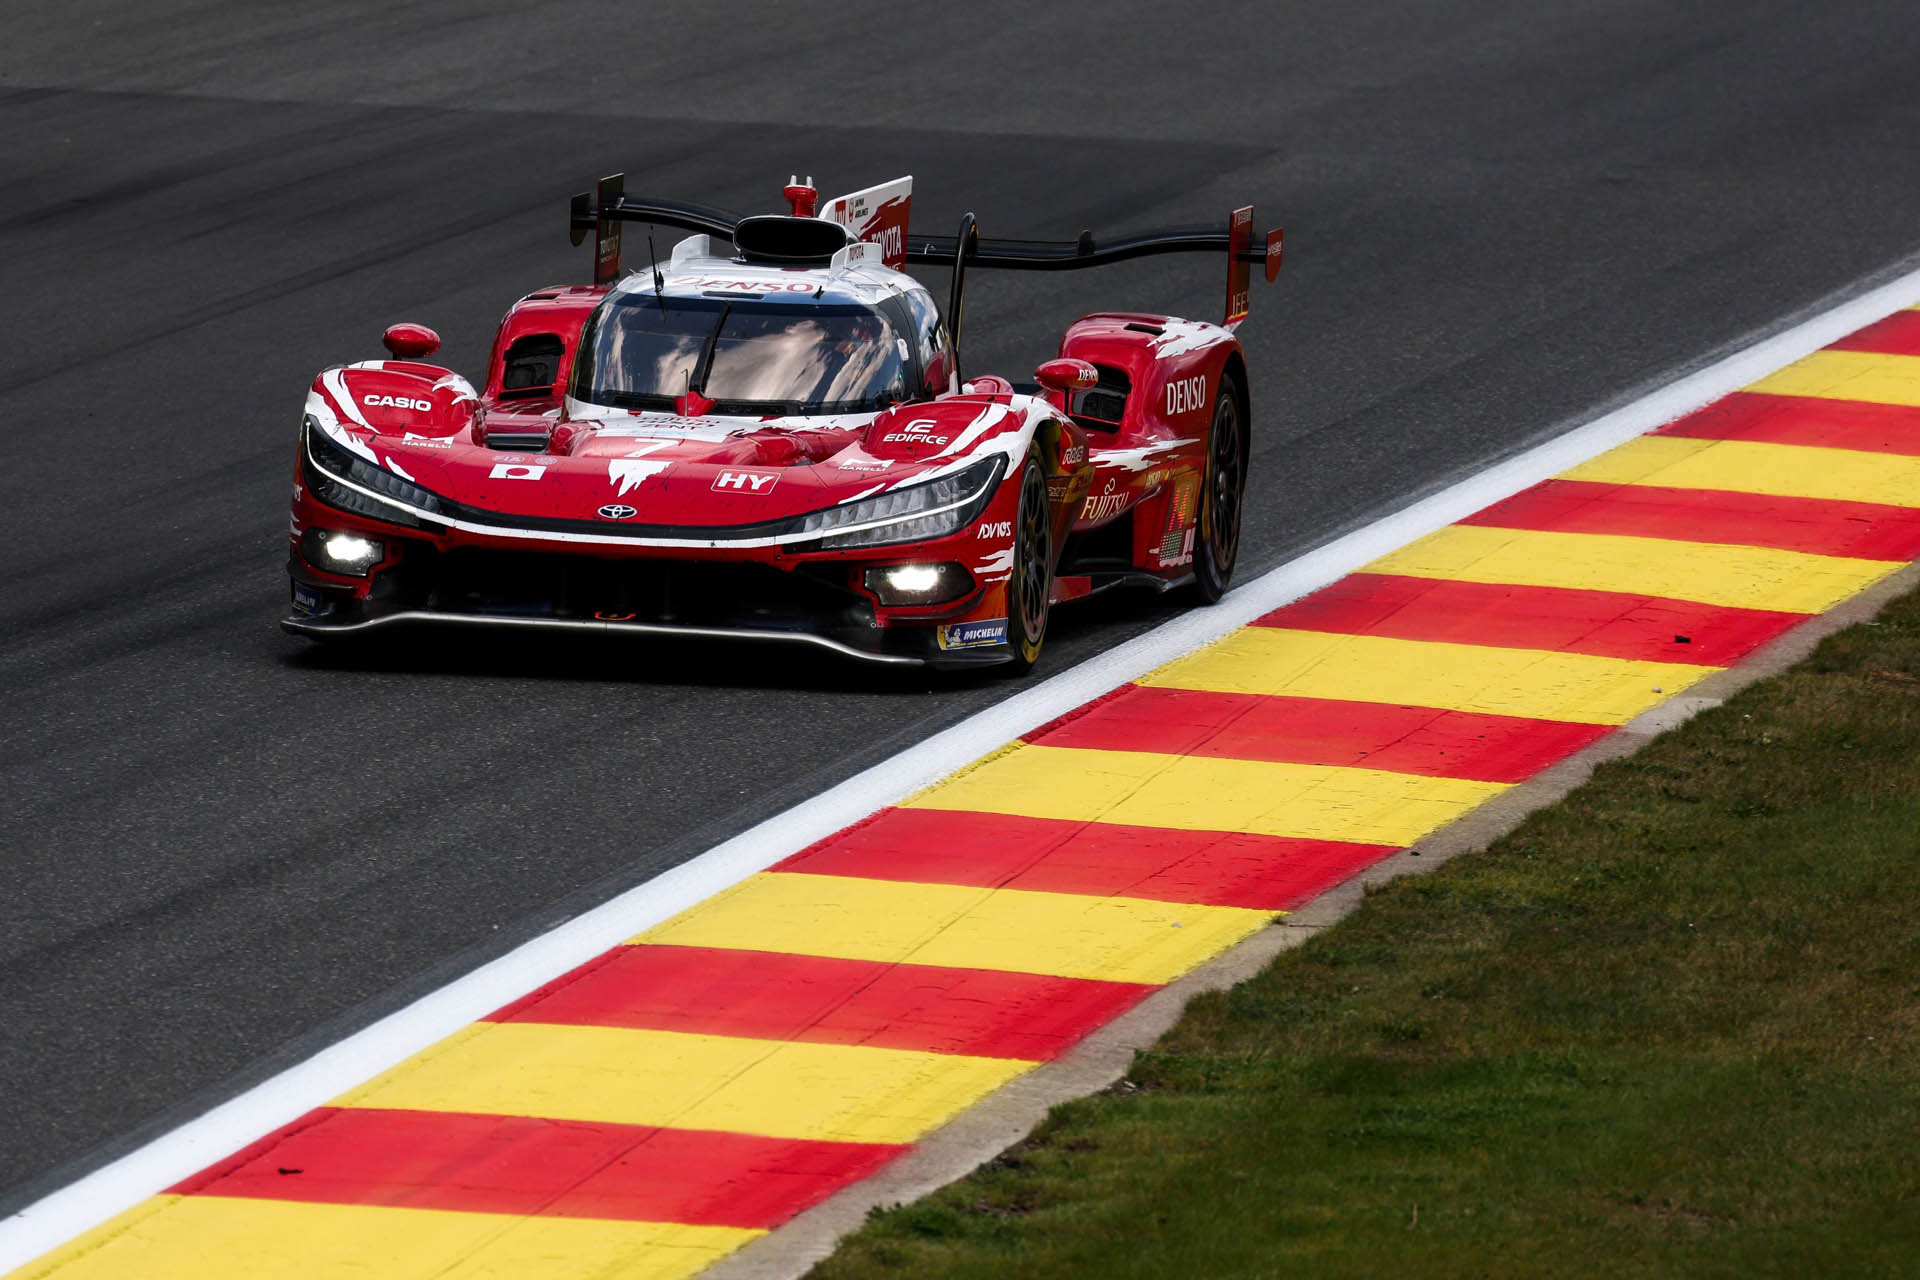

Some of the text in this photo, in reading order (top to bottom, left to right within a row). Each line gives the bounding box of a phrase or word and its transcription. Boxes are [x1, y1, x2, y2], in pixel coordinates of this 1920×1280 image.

[363, 394, 432, 412] CASIO
[1166, 375, 1206, 416] DENSO
[402, 441, 452, 449] MARELLI
[623, 438, 679, 458] 7
[883, 433, 949, 445] EDIFICE
[717, 472, 775, 491] HY
[1080, 491, 1130, 526] FUJITSU
[963, 627, 1004, 641] MICHELIN
